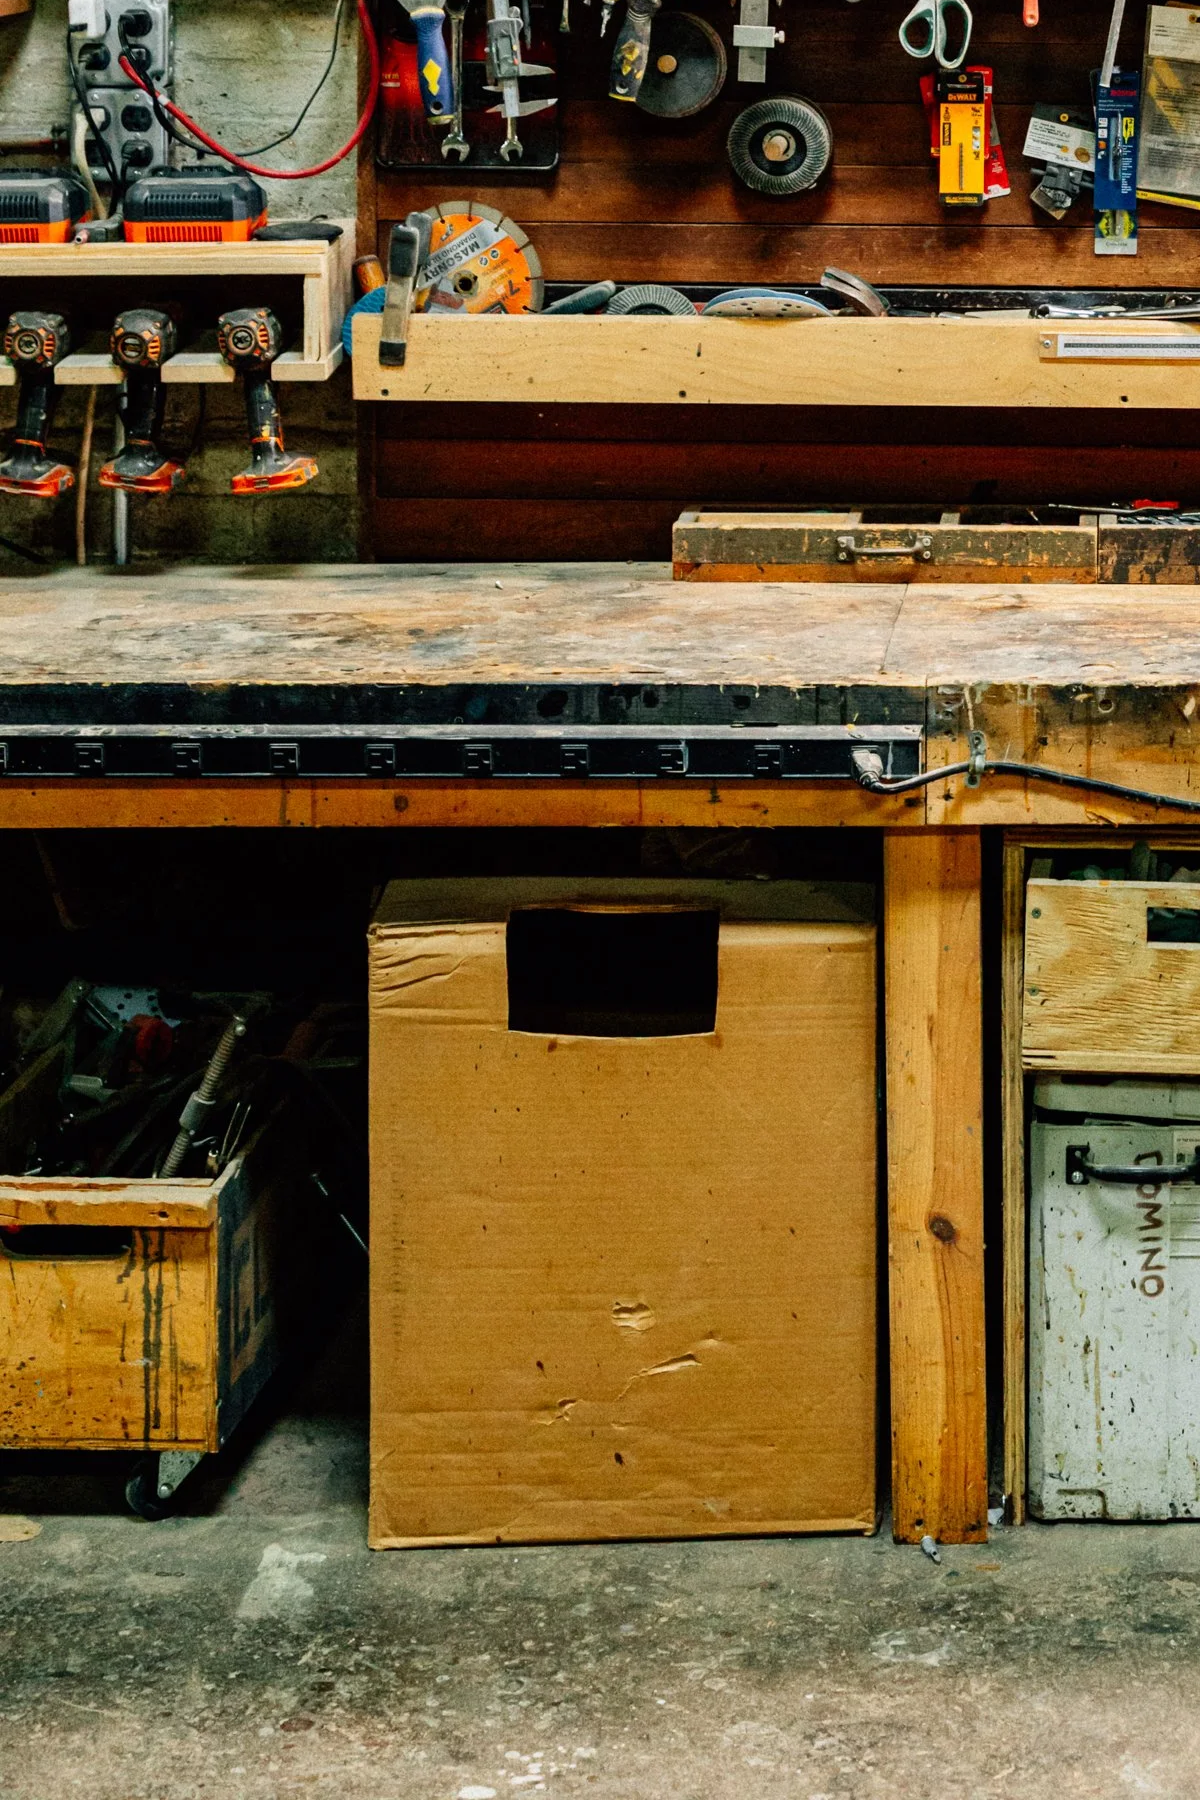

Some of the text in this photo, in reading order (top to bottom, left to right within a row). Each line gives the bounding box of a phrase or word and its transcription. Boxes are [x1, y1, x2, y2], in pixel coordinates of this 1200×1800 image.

[947, 93, 977, 102] DEWALT
[423, 241, 480, 282] MASONRY
[442, 232, 477, 258] DIAMOND
[1133, 1150, 1167, 1298] DOMINO
